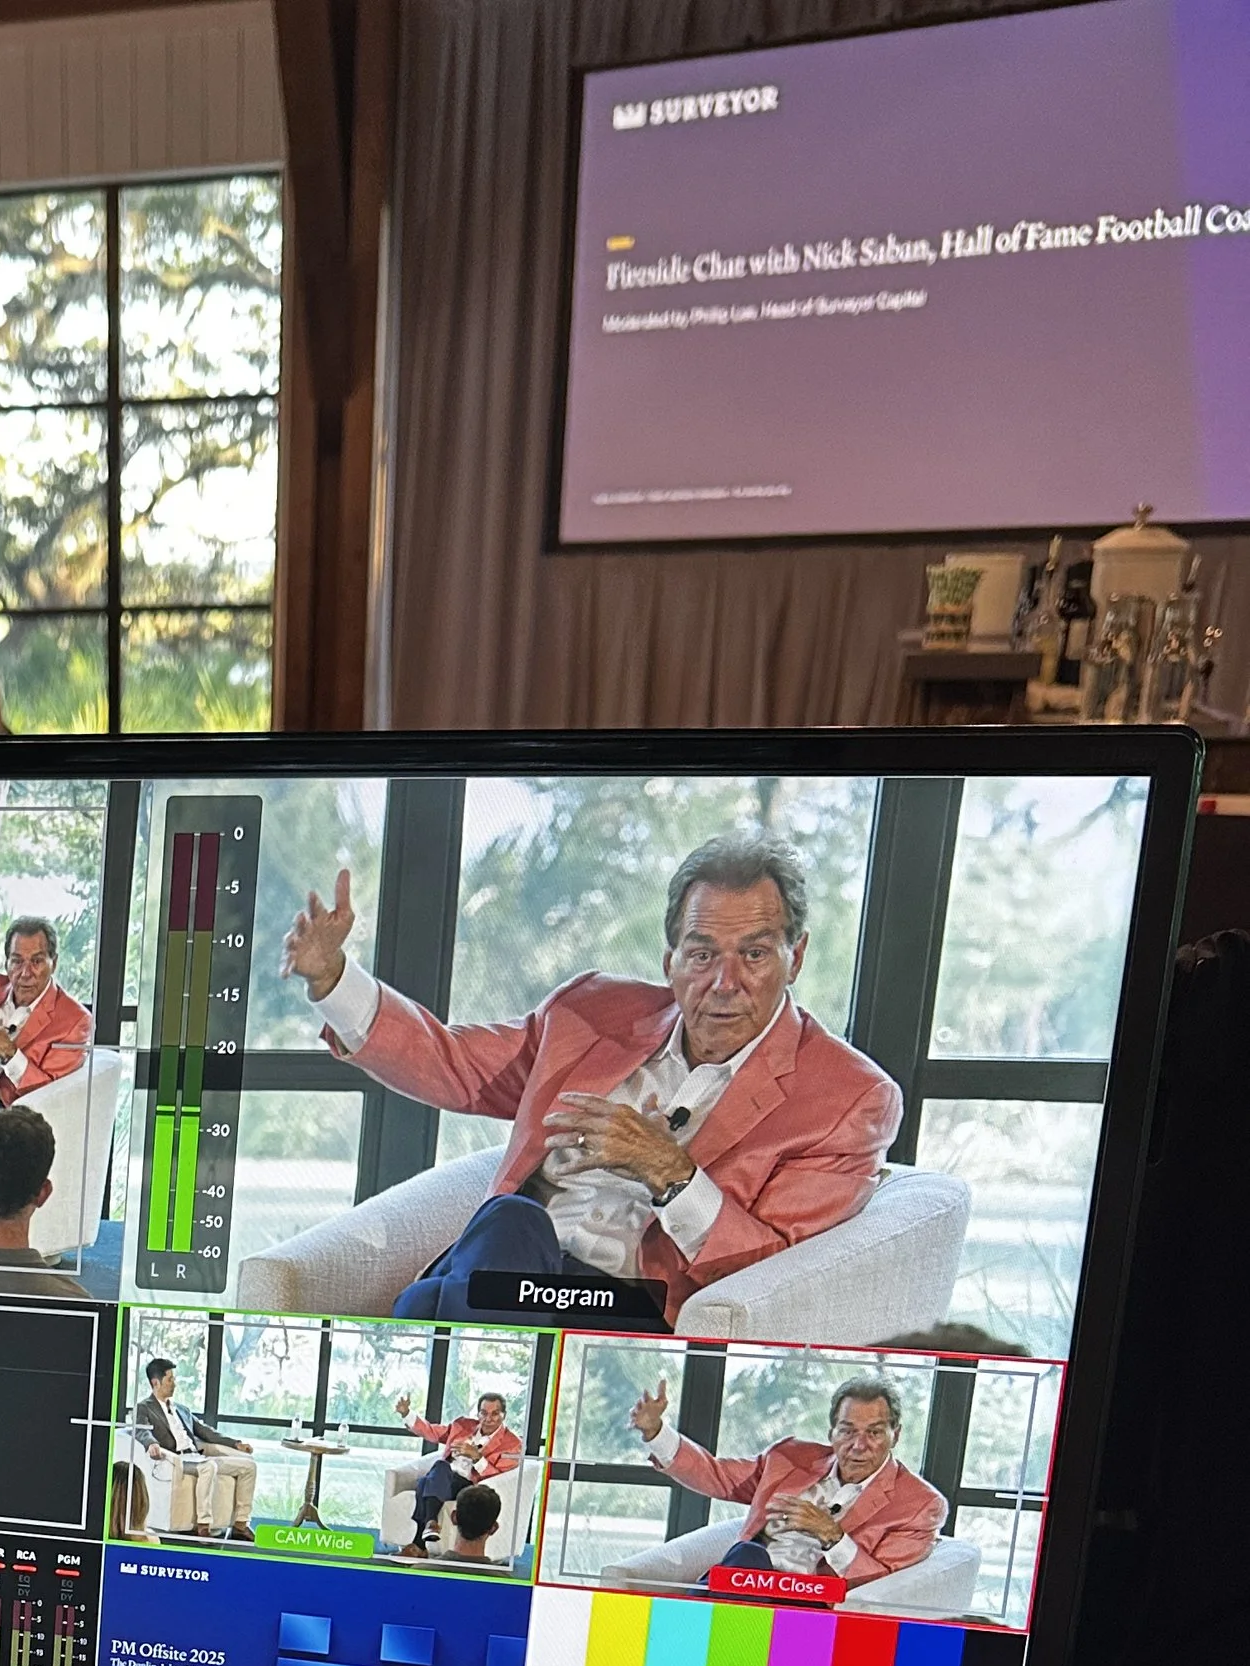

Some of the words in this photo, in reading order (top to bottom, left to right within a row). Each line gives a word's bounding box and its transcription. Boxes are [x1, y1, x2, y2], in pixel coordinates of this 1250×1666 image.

[650, 85, 779, 125] SURVEYOR
[606, 253, 691, 291] Fireside
[693, 250, 747, 282] Chat
[749, 244, 800, 276] with
[803, 237, 858, 272] Nick
[859, 232, 937, 266] Saban,
[941, 224, 994, 259] Hall
[995, 220, 1027, 254] of
[1024, 221, 1093, 251] Fame
[1095, 204, 1203, 245] Football
[233, 827, 244, 841] 0
[225, 881, 240, 894] -5
[220, 935, 244, 948] -10
[216, 989, 240, 1002] -15
[212, 1041, 236, 1054] -20
[206, 1124, 231, 1137] -30
[202, 1185, 226, 1198] -40
[199, 1216, 223, 1229] -50
[197, 1245, 221, 1258] -60
[518, 1280, 614, 1309] Program
[275, 1529, 311, 1546] CAM
[315, 1533, 353, 1551] Wide
[16, 1549, 36, 1561] RCA
[58, 1554, 81, 1566] PGM
[140, 1565, 209, 1582] SURVEYOR
[730, 1572, 774, 1591] CAM
[778, 1577, 825, 1596] Close
[111, 1639, 137, 1655] PM
[139, 1643, 187, 1661] Offsite
[189, 1649, 225, 1665] 2025
